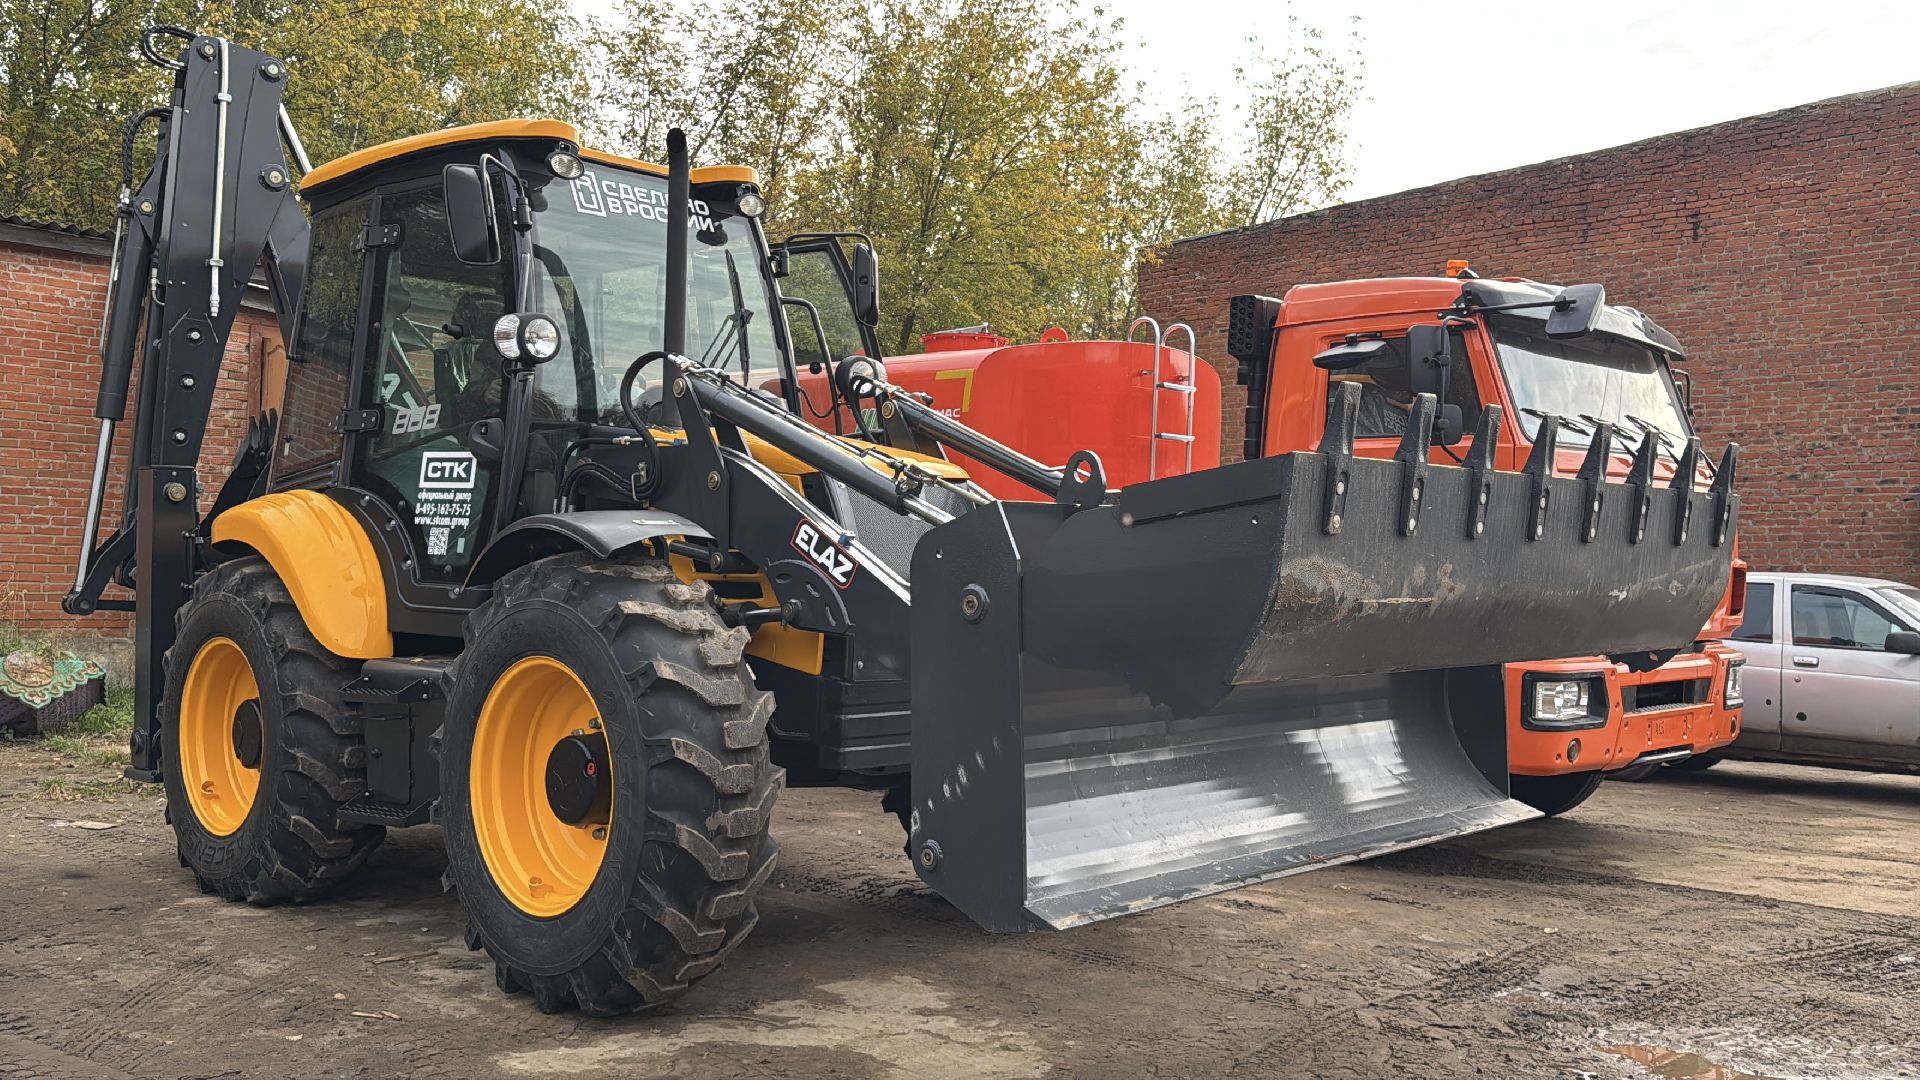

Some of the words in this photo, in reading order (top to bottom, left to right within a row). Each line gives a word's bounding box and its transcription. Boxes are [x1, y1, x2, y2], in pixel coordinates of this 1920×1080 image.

[427, 461, 469, 478] СТК
[418, 489, 454, 501] официальный
[454, 492, 472, 502] дилер
[415, 502, 471, 516] 8-495-162-75-75
[795, 523, 854, 583] ELAZ
